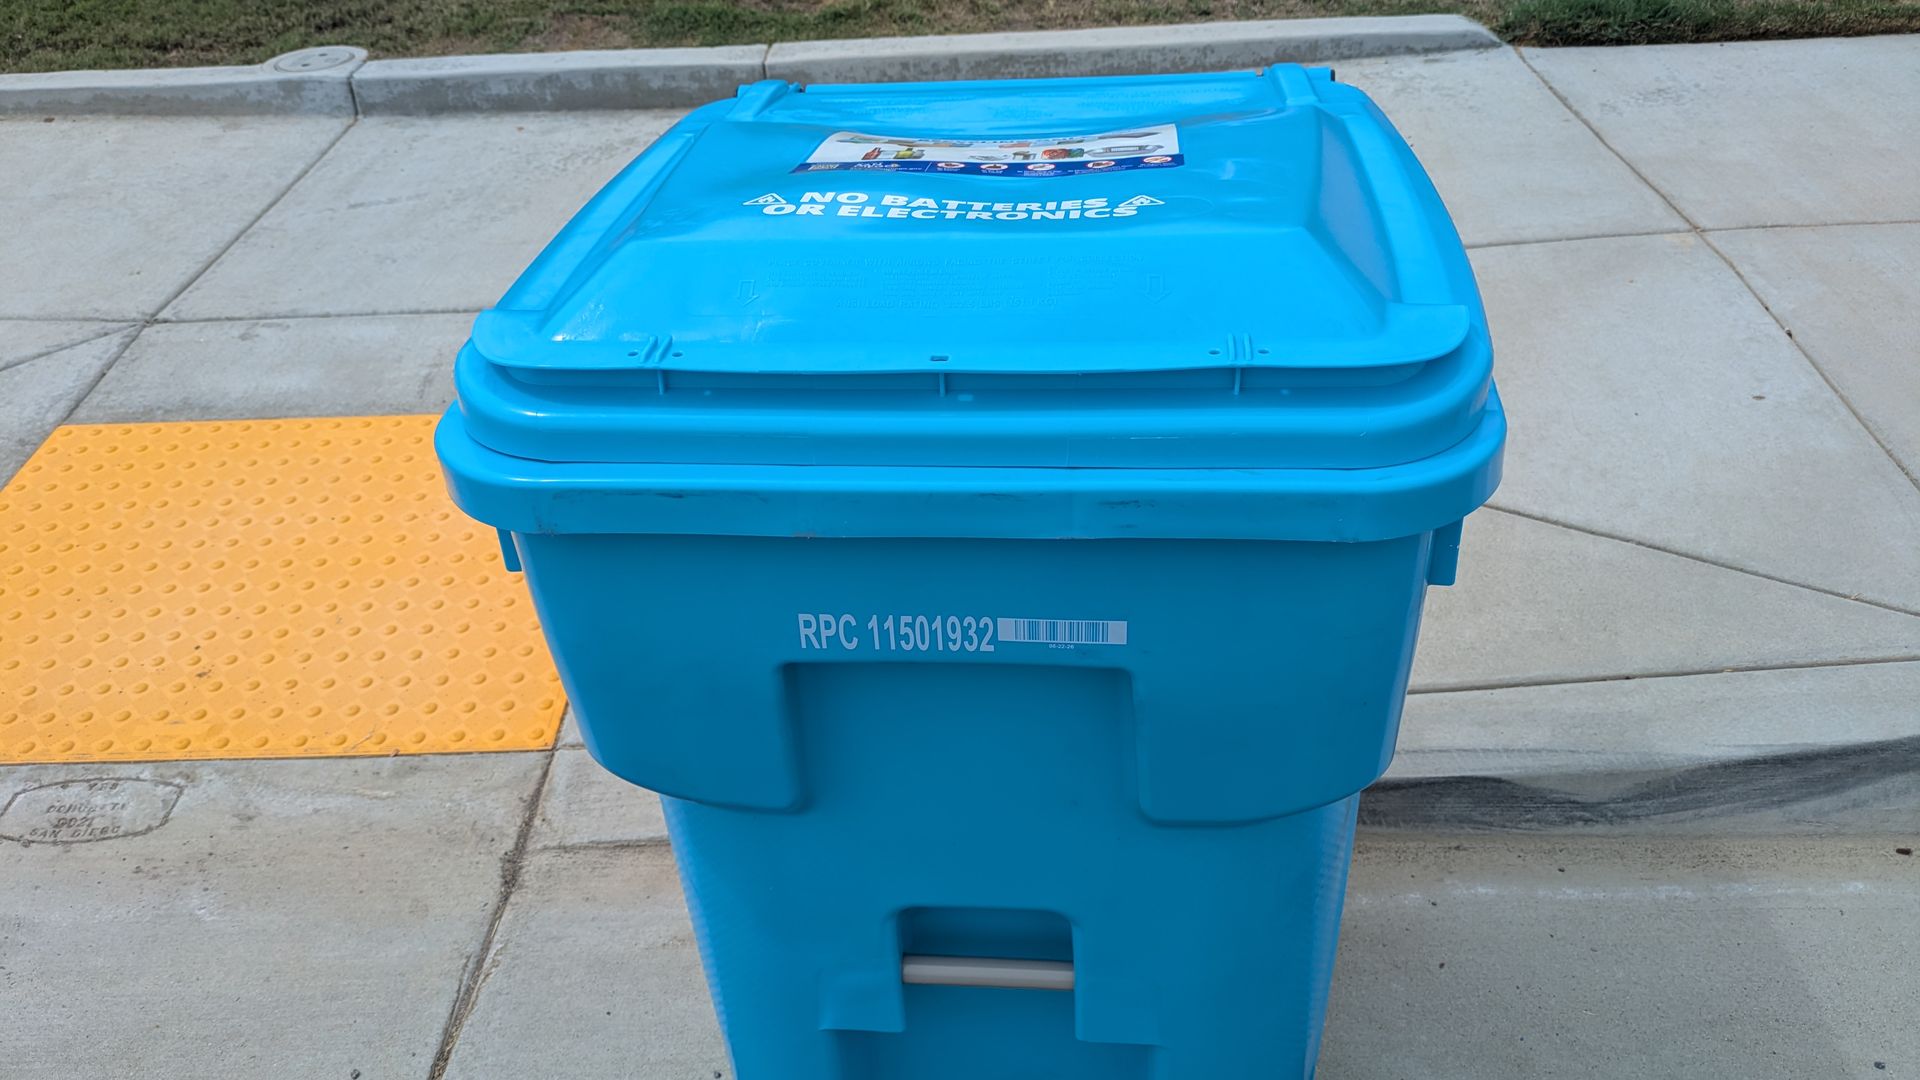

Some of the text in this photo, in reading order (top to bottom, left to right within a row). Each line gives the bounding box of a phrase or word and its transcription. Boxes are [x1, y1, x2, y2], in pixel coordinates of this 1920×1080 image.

[800, 191, 1110, 212] NO BATTERIES
[762, 203, 1140, 221] OR ELECTRONICS
[797, 613, 995, 652] RPC 11501932
[29, 825, 122, 839] SAN DIEGO
